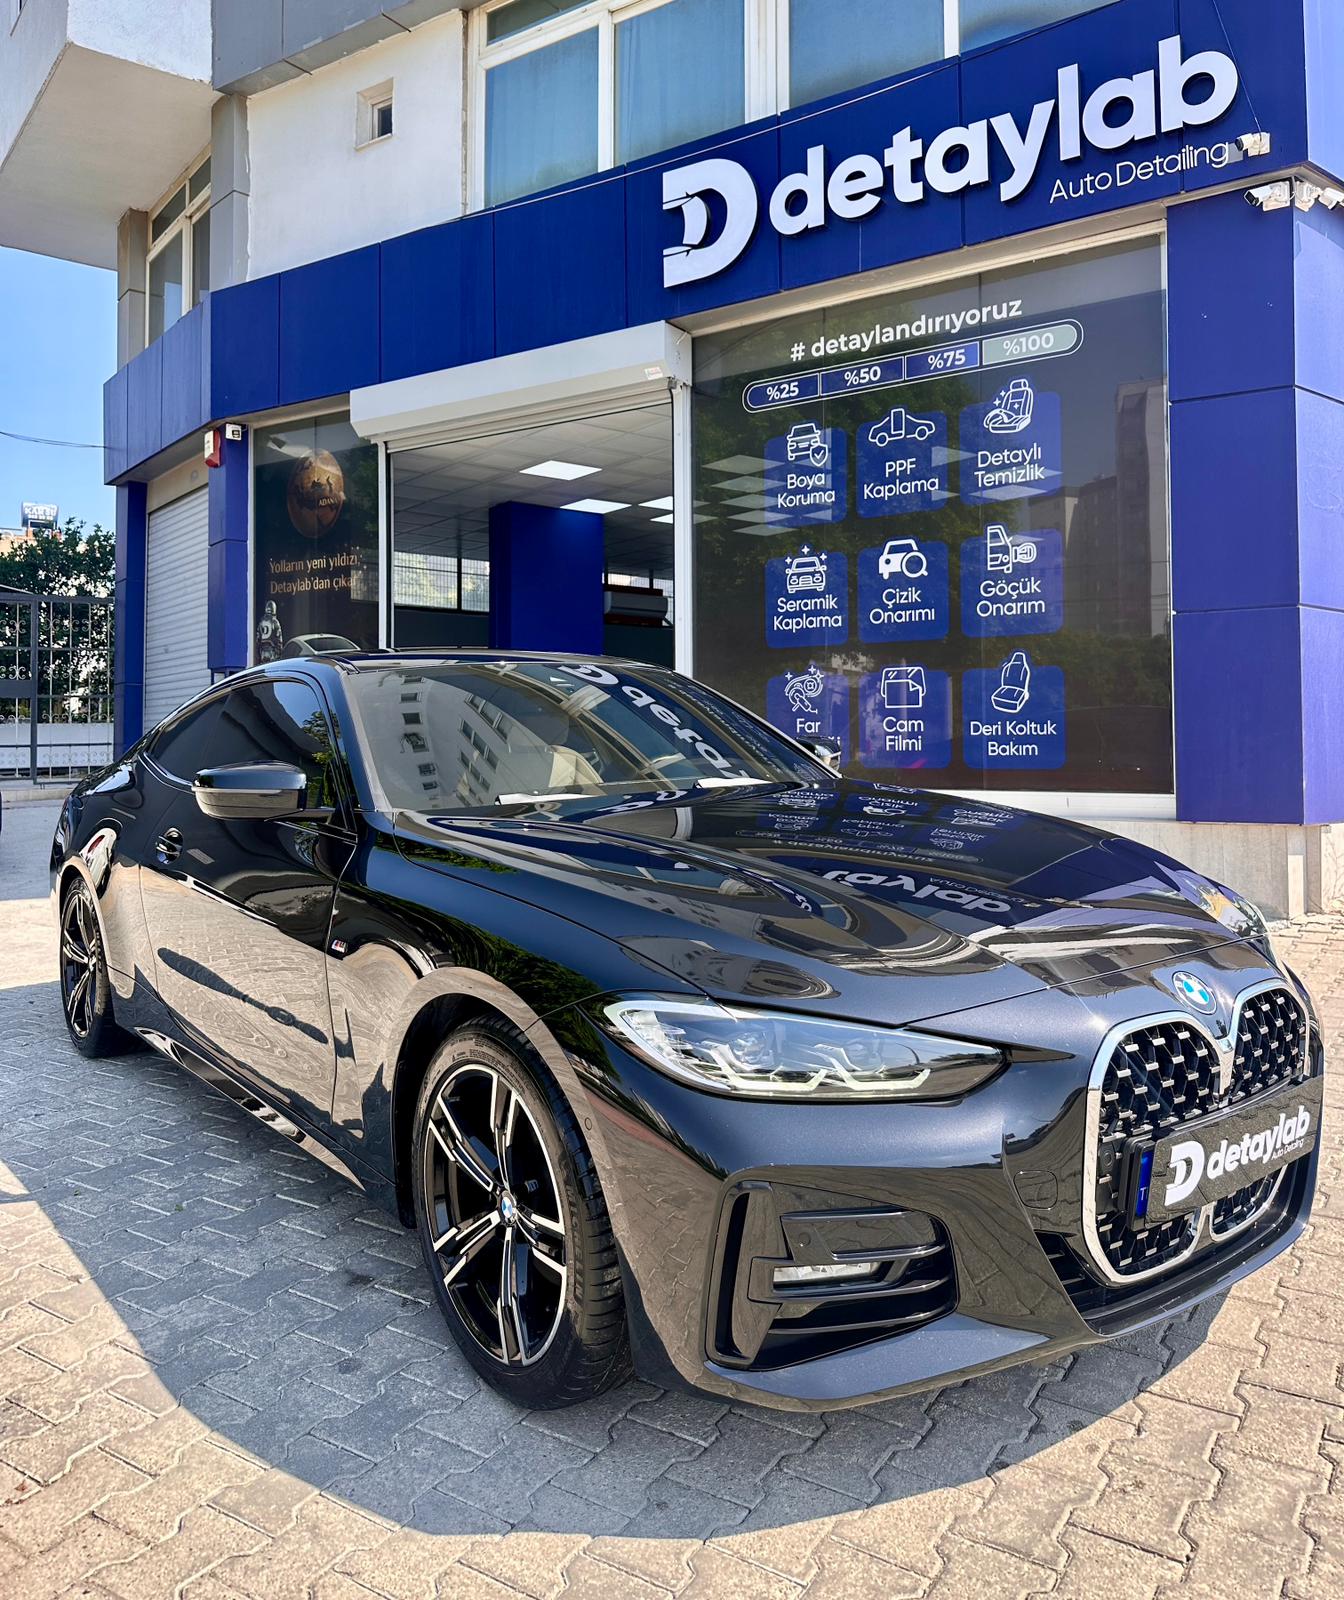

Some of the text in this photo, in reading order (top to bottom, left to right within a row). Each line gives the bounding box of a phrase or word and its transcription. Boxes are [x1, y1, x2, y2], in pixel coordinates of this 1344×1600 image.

[768, 35, 1239, 235] detaylab
[1050, 140, 1231, 203] Auto Detailing
[811, 299, 1023, 359] detaylandırıyoruz
[766, 332, 1055, 401] %25 %50 %75 %100
[977, 445, 1042, 469] Detaylı
[885, 458, 917, 477] PPF
[973, 463, 1045, 489] Temizlik
[787, 472, 825, 490] Boya
[863, 475, 939, 501] Kaplama
[777, 490, 835, 508] Koruma
[270, 560, 304, 573] Yolların
[307, 556, 326, 573] yeni
[882, 587, 922, 606] Çizik
[980, 577, 1041, 601] Göçük
[777, 595, 838, 613] Seramik
[976, 598, 1046, 618] Onarım
[773, 612, 842, 633] Kaplama
[869, 606, 935, 625] Onarımı
[796, 717, 821, 733] Far
[883, 716, 924, 733] Cam
[970, 719, 1057, 737] Deri Koltuk
[886, 735, 922, 752] Filmi
[987, 739, 1038, 757] Bakım
[1207, 1105, 1310, 1179] detaylab
